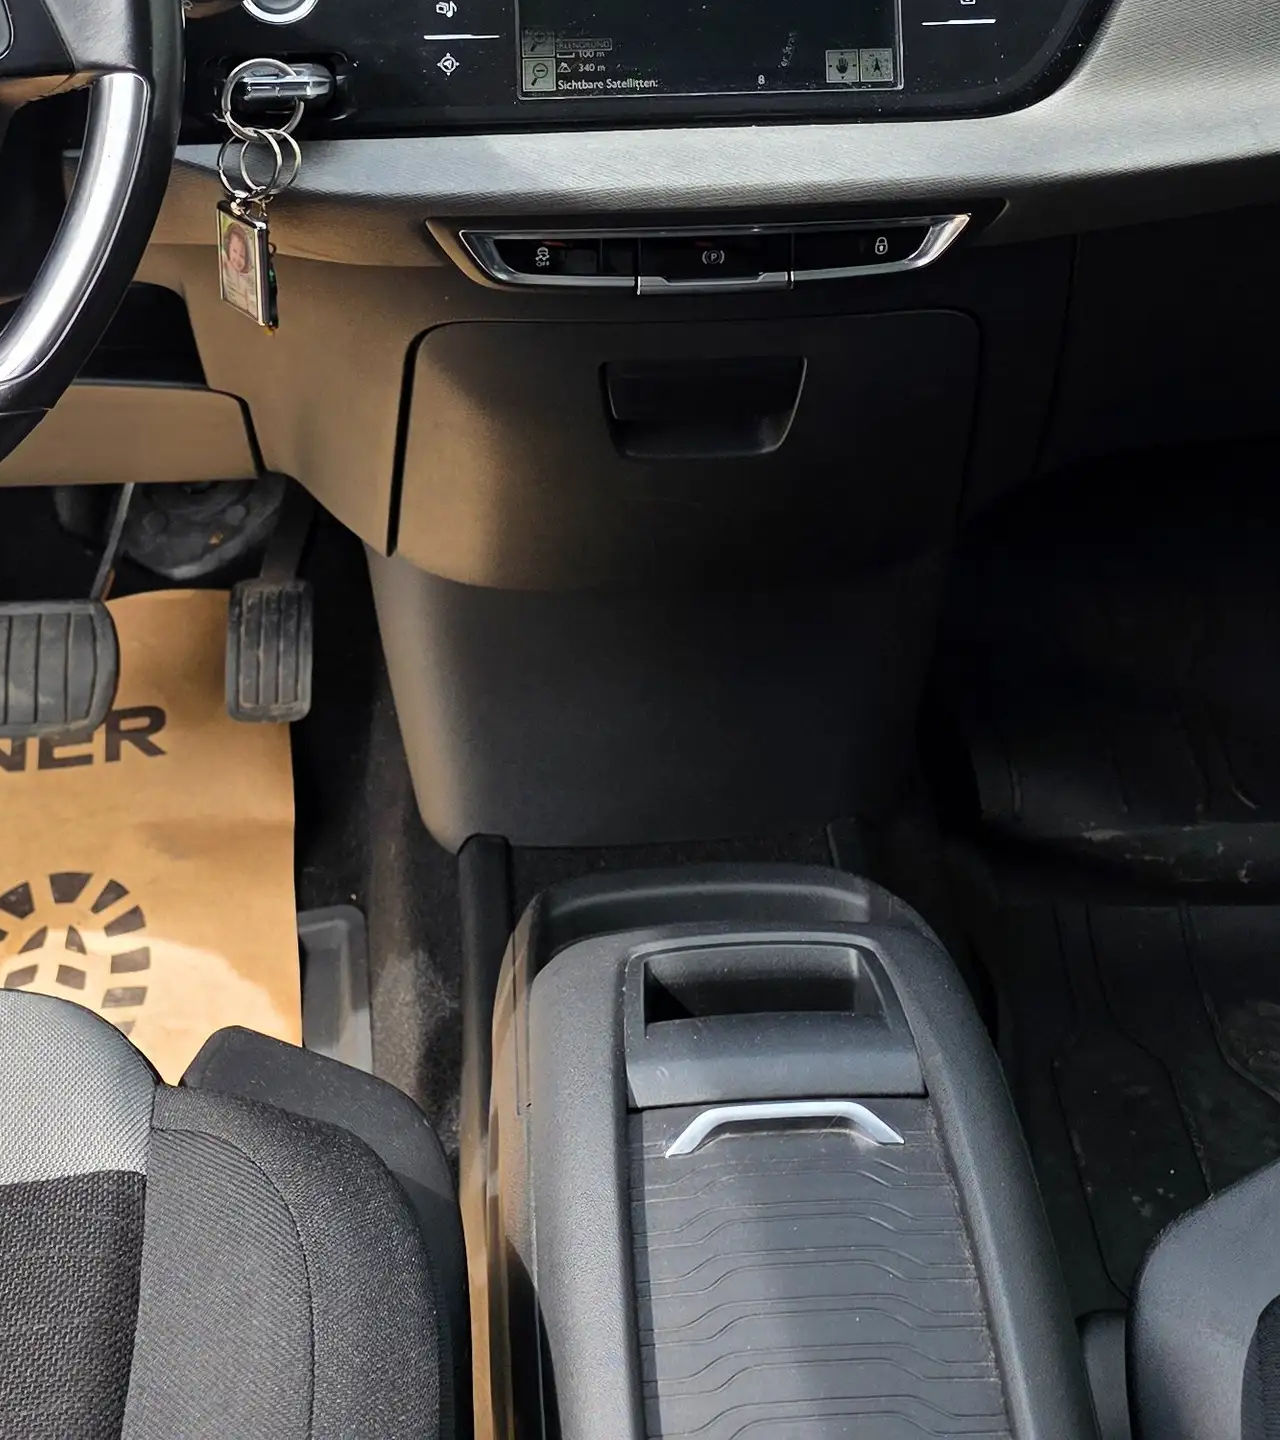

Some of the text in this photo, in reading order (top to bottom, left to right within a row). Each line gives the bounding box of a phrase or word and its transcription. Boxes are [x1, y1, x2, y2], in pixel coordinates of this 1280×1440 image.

[578, 50, 595, 58] 100
[578, 63, 596, 72] 340
[557, 78, 604, 90] Sichtbare
[757, 74, 766, 85] 8
